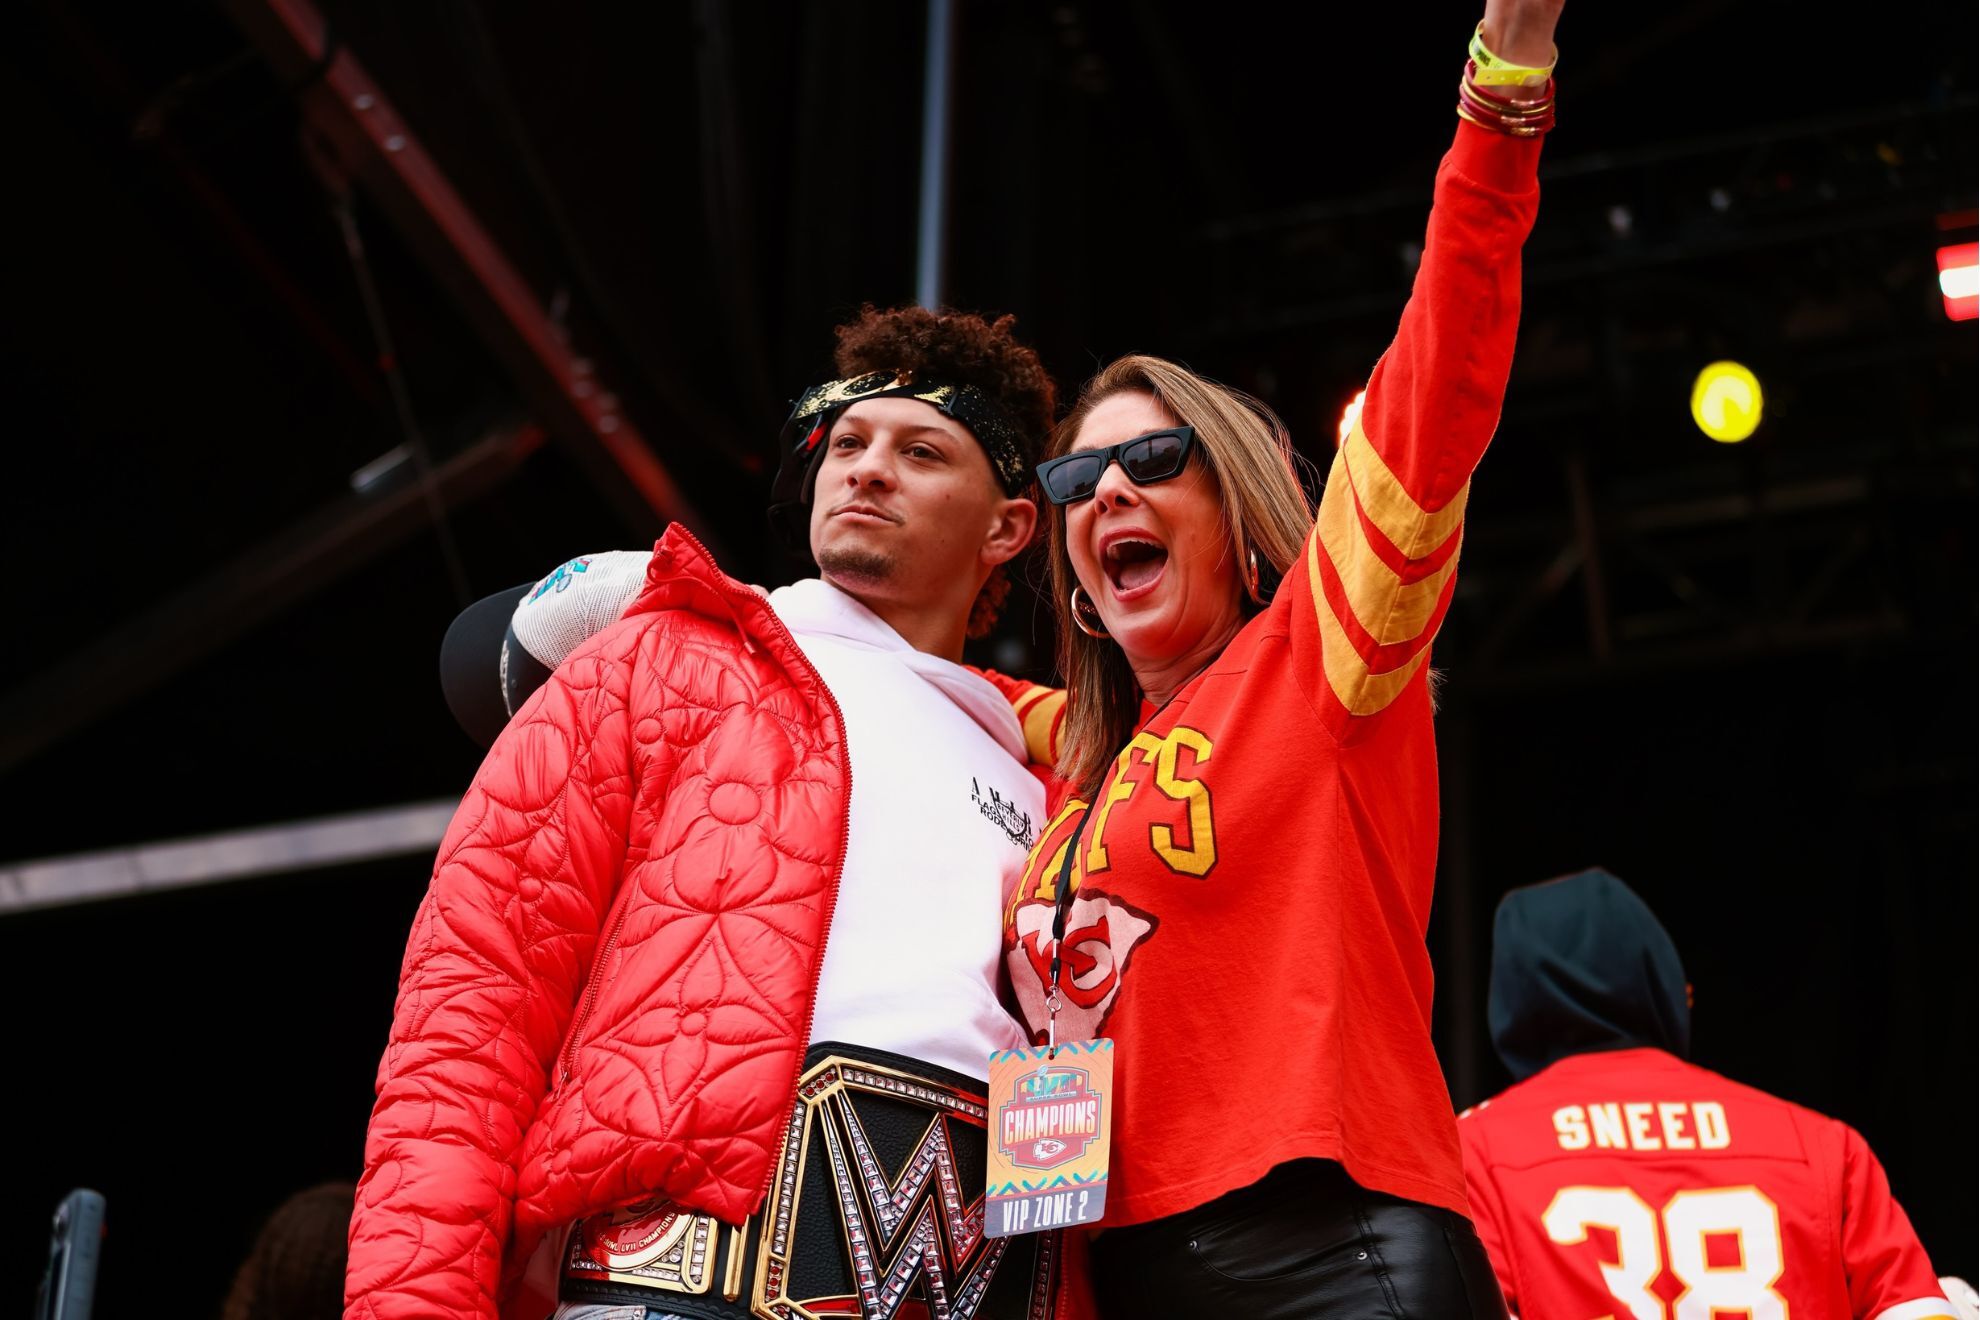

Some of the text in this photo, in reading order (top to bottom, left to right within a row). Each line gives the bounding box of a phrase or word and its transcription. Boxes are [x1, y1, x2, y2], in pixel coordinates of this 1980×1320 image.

[1004, 1100, 1096, 1145] CHAMPIONS
[1552, 1100, 1731, 1151] SNEED
[1003, 1190, 1088, 1232] VIP ZONE 2
[1541, 1184, 1789, 1320] 38
